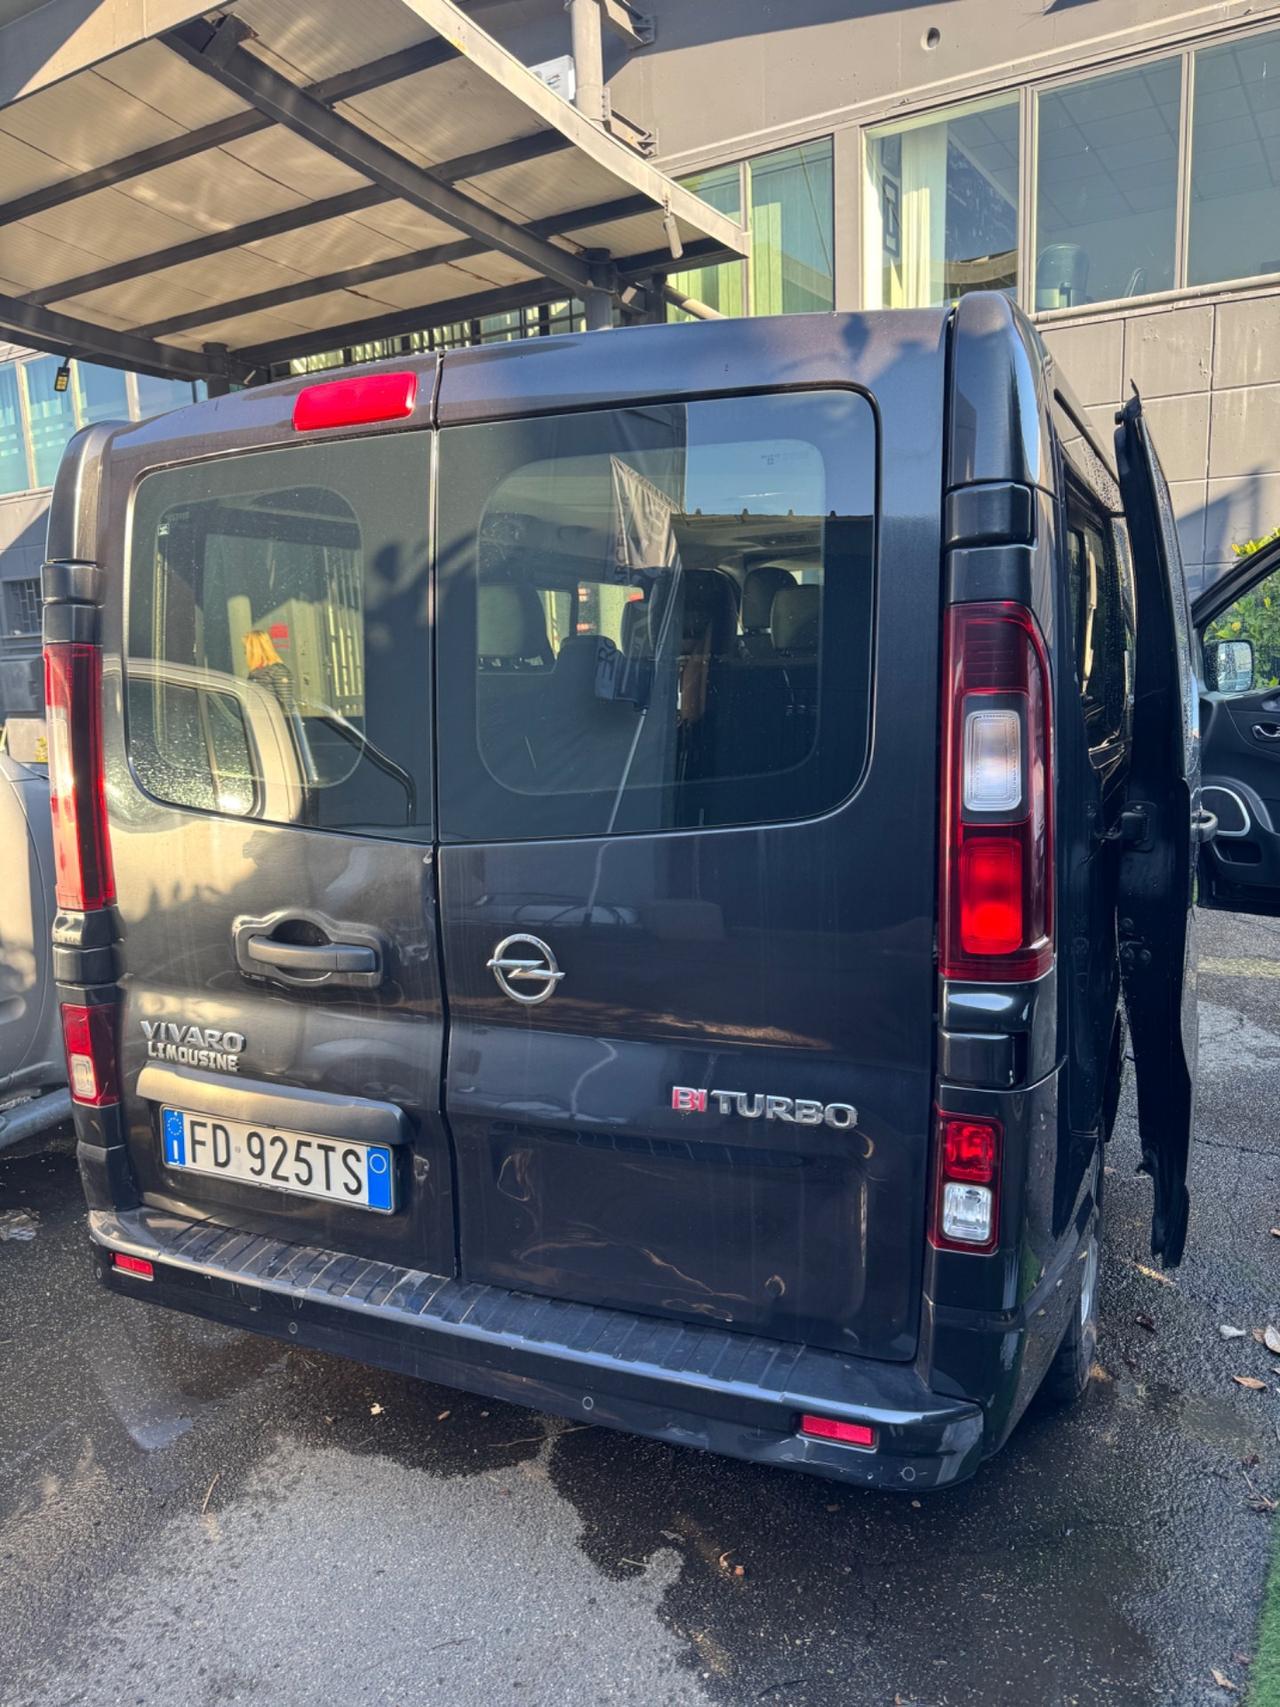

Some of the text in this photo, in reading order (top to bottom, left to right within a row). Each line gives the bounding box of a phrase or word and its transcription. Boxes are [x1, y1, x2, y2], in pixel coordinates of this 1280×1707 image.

[140, 1020, 246, 1053] VIVARO
[147, 1041, 239, 1072] LIMOUSINE
[189, 1119, 231, 1168] FD
